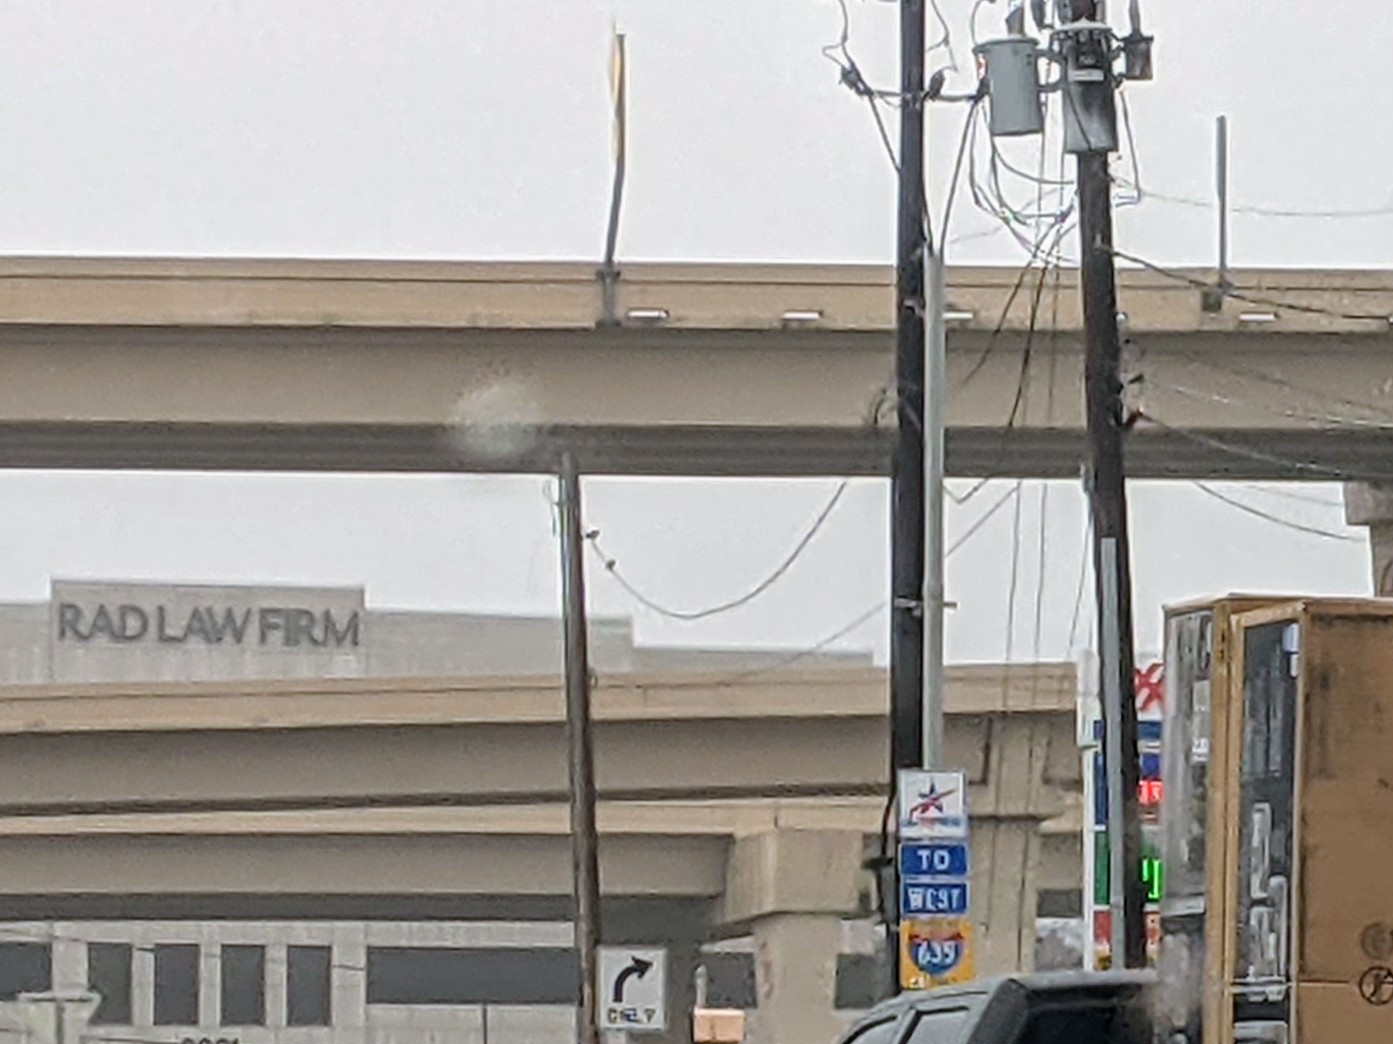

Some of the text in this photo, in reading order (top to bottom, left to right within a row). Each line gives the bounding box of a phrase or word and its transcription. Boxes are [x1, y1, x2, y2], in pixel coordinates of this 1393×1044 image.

[57, 603, 359, 647] RAD LAW FIRM
[916, 850, 950, 871] TO
[907, 887, 962, 912] WEST
